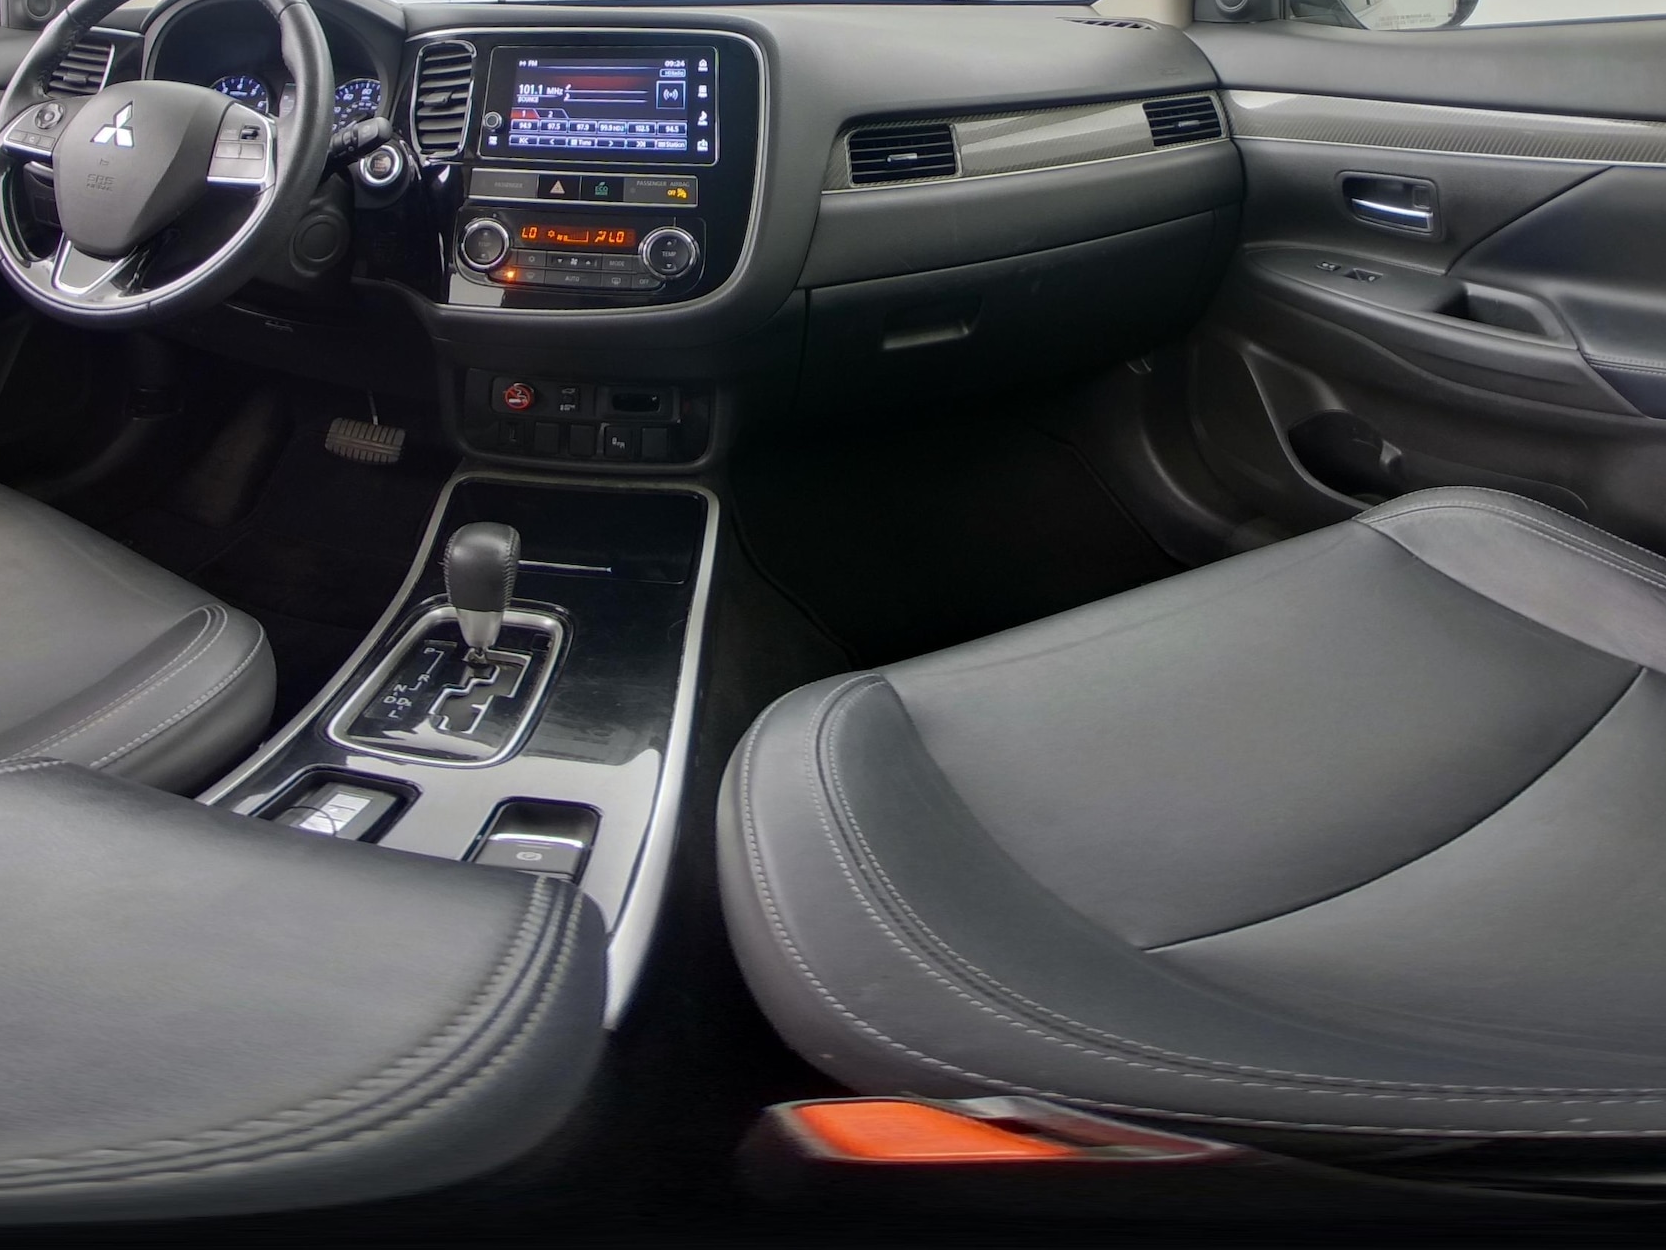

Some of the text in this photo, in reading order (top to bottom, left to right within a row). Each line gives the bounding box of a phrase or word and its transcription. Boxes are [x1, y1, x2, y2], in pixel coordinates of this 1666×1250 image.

[518, 84, 563, 95] 101.1 MHz
[417, 674, 430, 682] R
[393, 684, 407, 692] N
[383, 695, 397, 704] D
[387, 710, 399, 718] L
